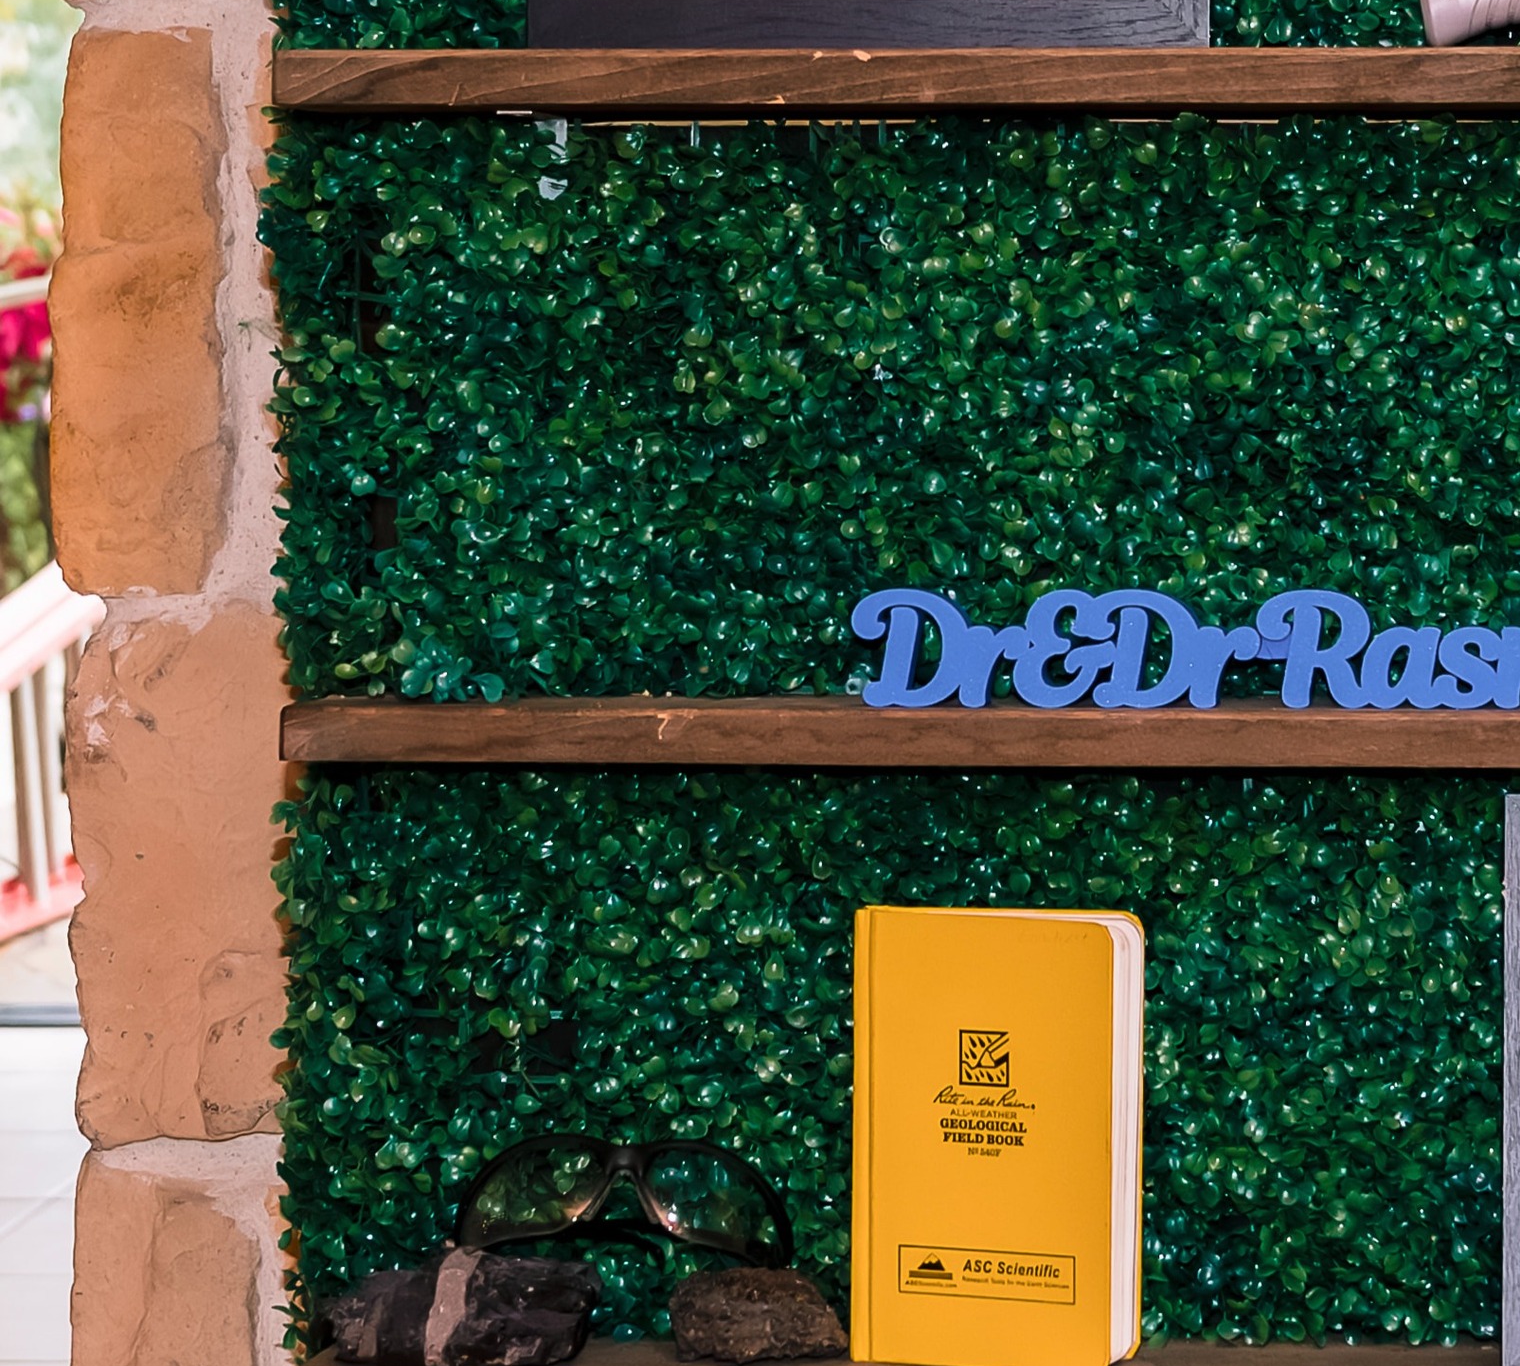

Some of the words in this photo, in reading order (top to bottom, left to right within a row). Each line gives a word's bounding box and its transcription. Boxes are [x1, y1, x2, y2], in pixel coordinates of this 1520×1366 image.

[933, 1085, 964, 1105] Rite
[961, 1097, 974, 1105] in
[976, 1097, 995, 1106] the
[950, 1108, 1017, 1119] ALL-WEATHER
[940, 1118, 1027, 1133] GEOLOGICAL
[943, 1132, 984, 1144] FIELD
[987, 1134, 1024, 1146] BOOK
[963, 1259, 992, 1274] ASC
[997, 1261, 1060, 1278] Scientific
